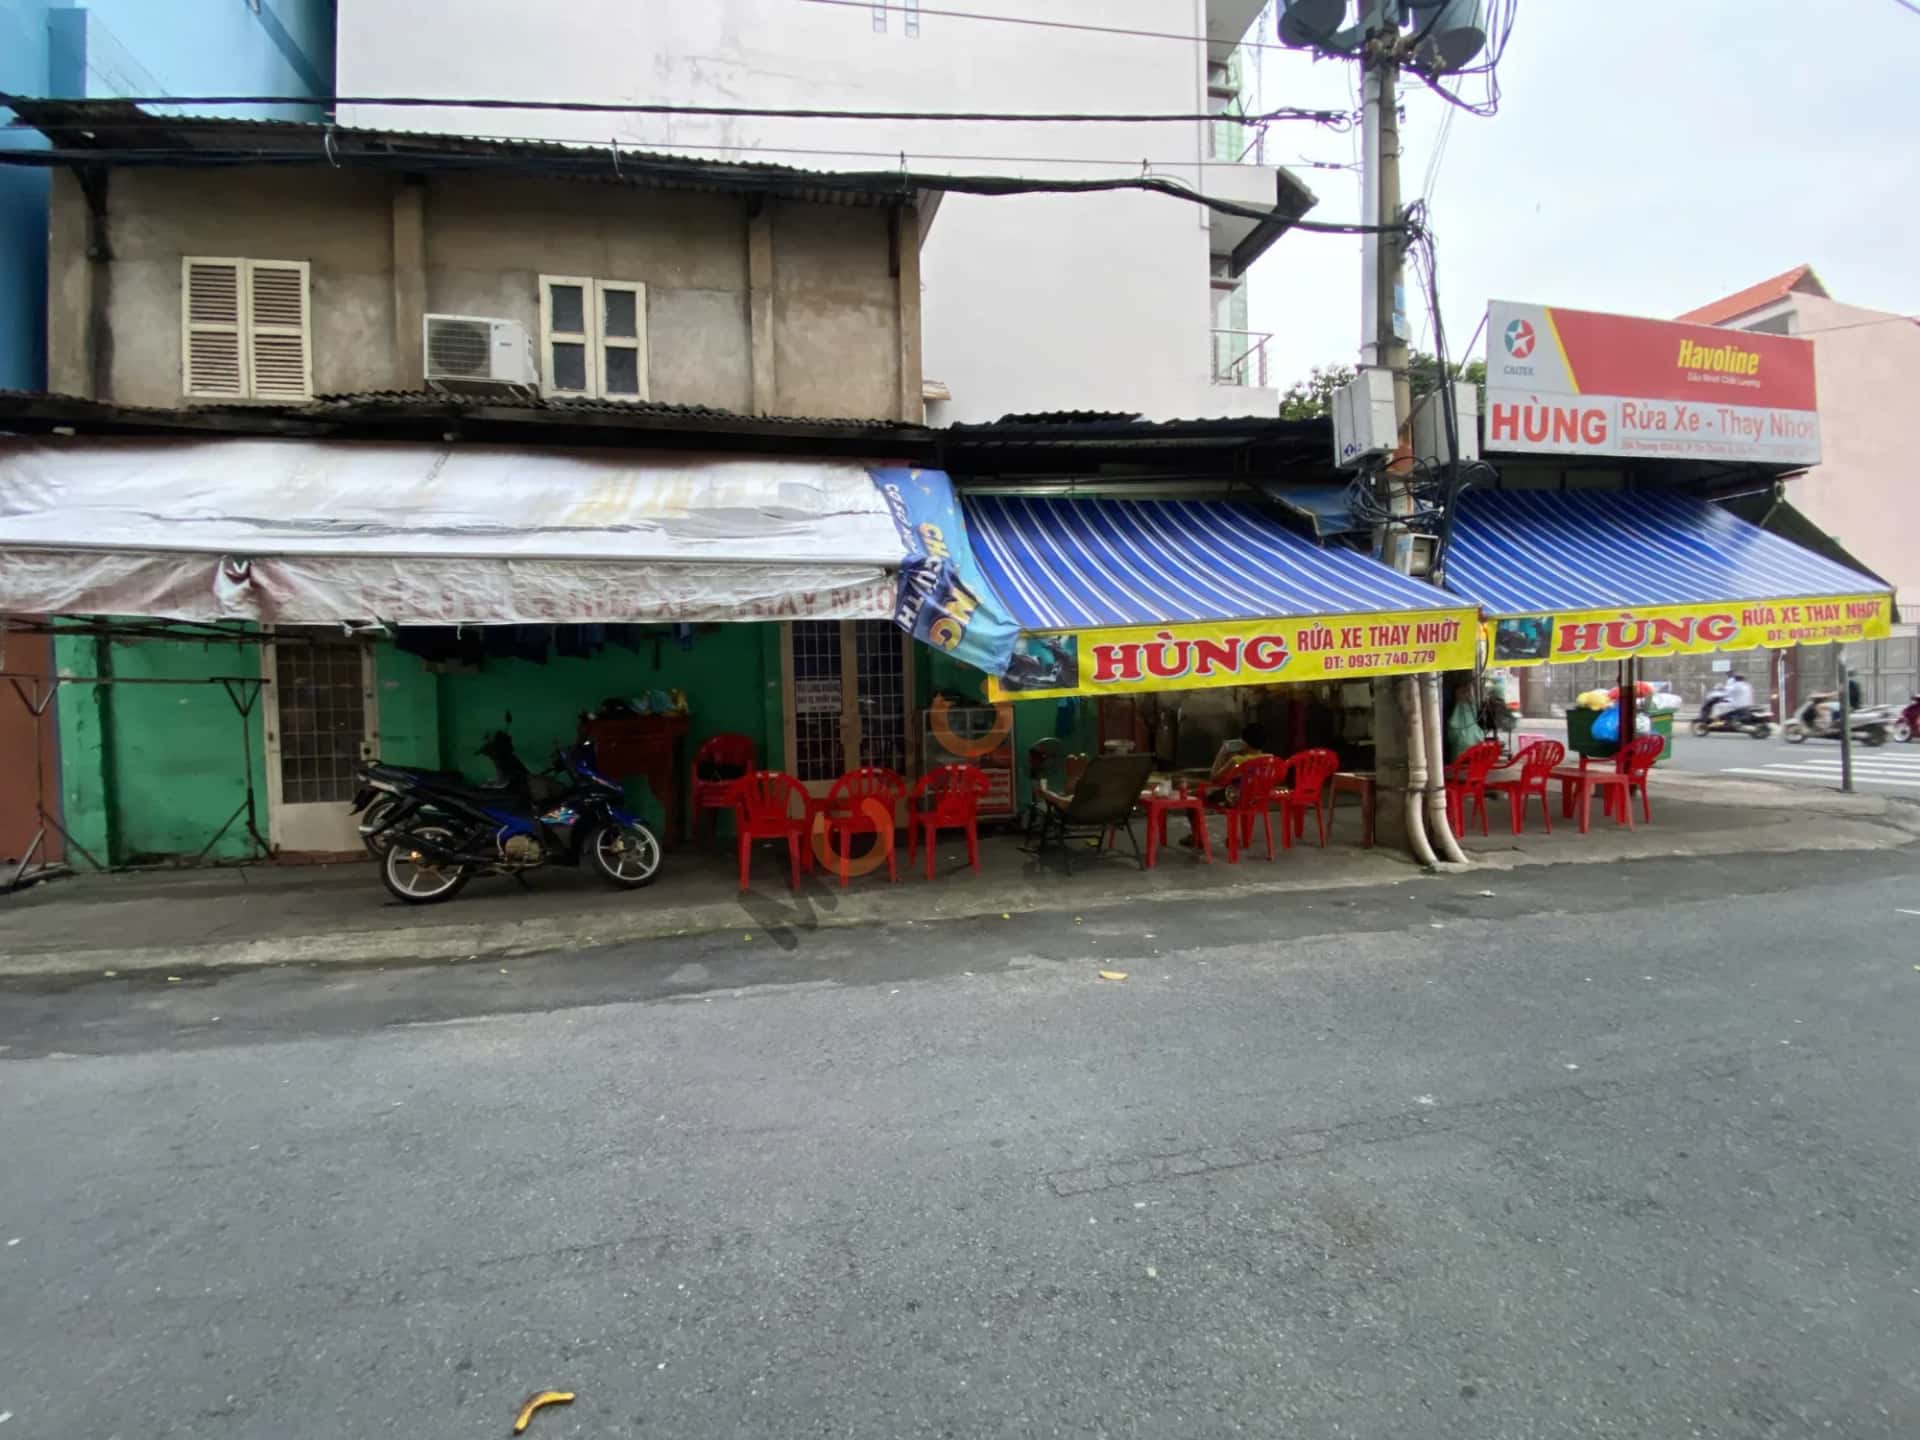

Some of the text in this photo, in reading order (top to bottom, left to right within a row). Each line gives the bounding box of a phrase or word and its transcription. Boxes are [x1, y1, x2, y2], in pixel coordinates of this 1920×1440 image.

[1677, 339, 1760, 376] Havoline
[1492, 395, 1608, 445] HÙNG
[1674, 404, 1701, 433] Xe
[1717, 409, 1764, 443] Thay
[1557, 612, 1738, 653] HÙNG
[1781, 605, 1800, 624] XE
[1804, 604, 1841, 623] THAY
[1297, 618, 1461, 652] RỬA XE THAY NHỚT
[1092, 631, 1290, 682] HÙNG
